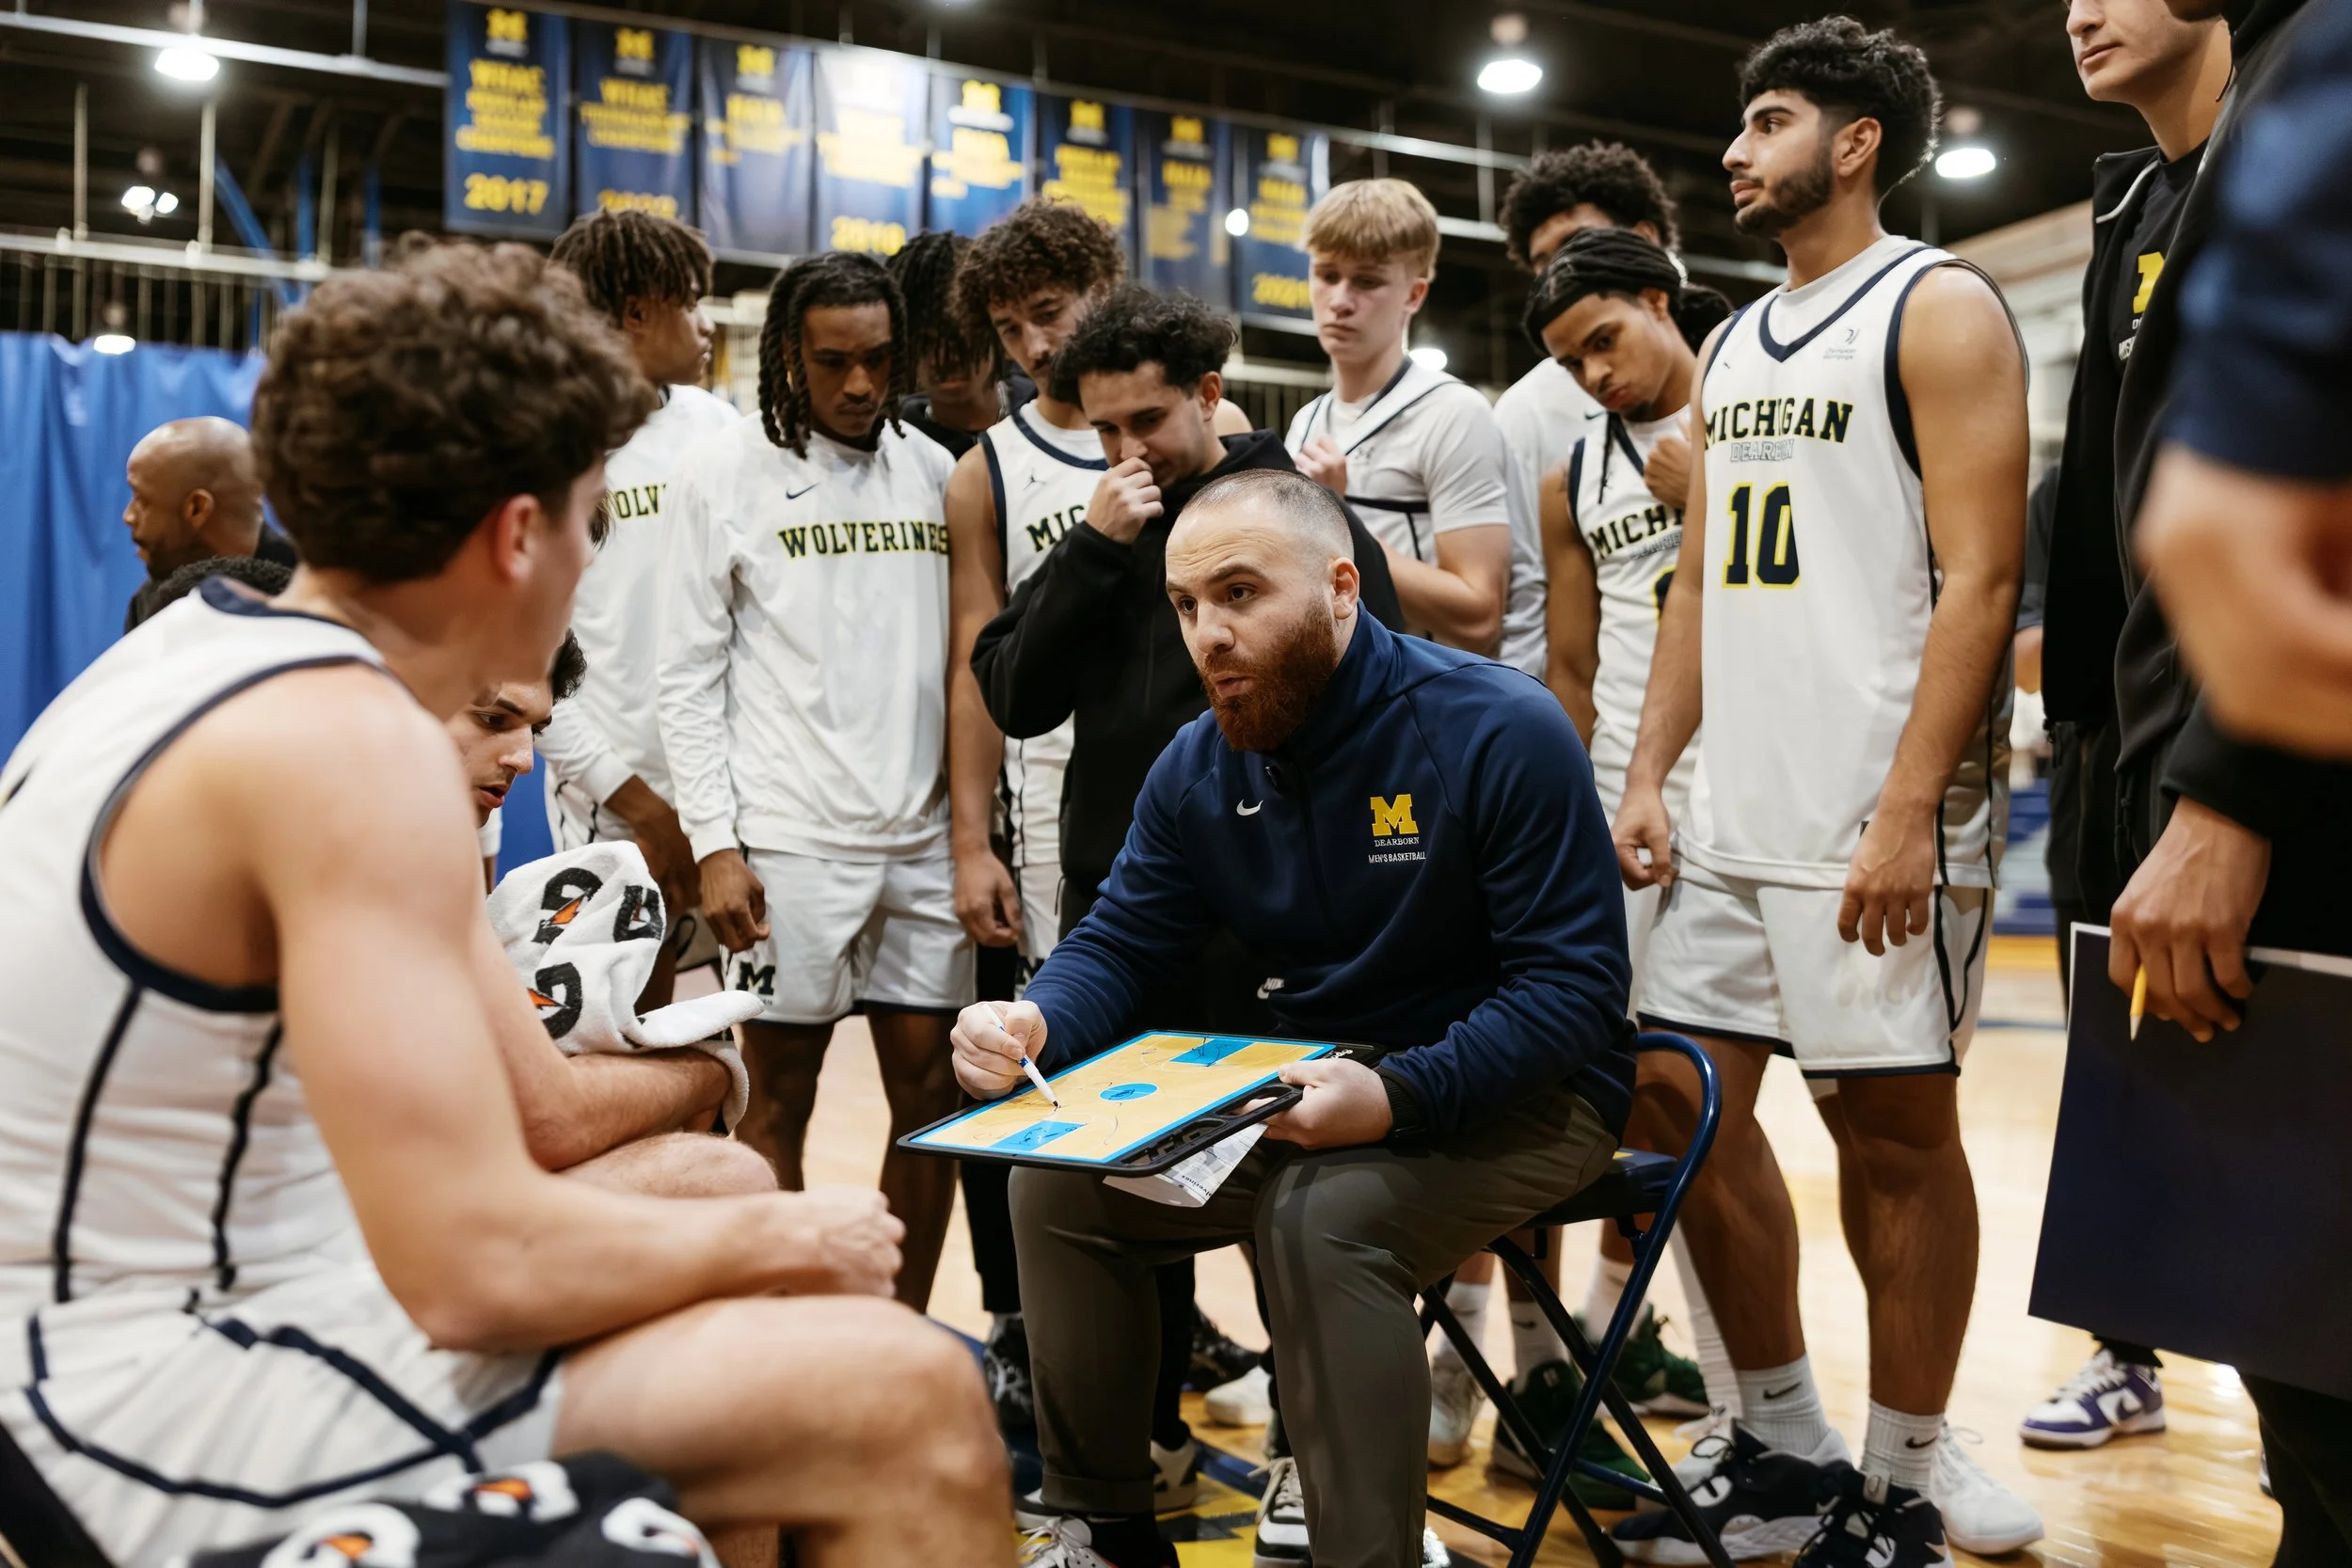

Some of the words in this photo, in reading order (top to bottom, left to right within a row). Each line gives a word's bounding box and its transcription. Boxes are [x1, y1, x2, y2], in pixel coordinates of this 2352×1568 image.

[464, 172, 549, 215] 2017
[615, 482, 667, 518] OLV
[778, 520, 949, 560] WOLVERINES
[1722, 481, 1801, 590] 10
[1370, 794, 1419, 836] M
[1368, 853, 1388, 863] MEN'S
[1389, 851, 1426, 863] BASKETBALL
[1374, 837, 1420, 847] DEARBORN
[736, 960, 776, 995] M
